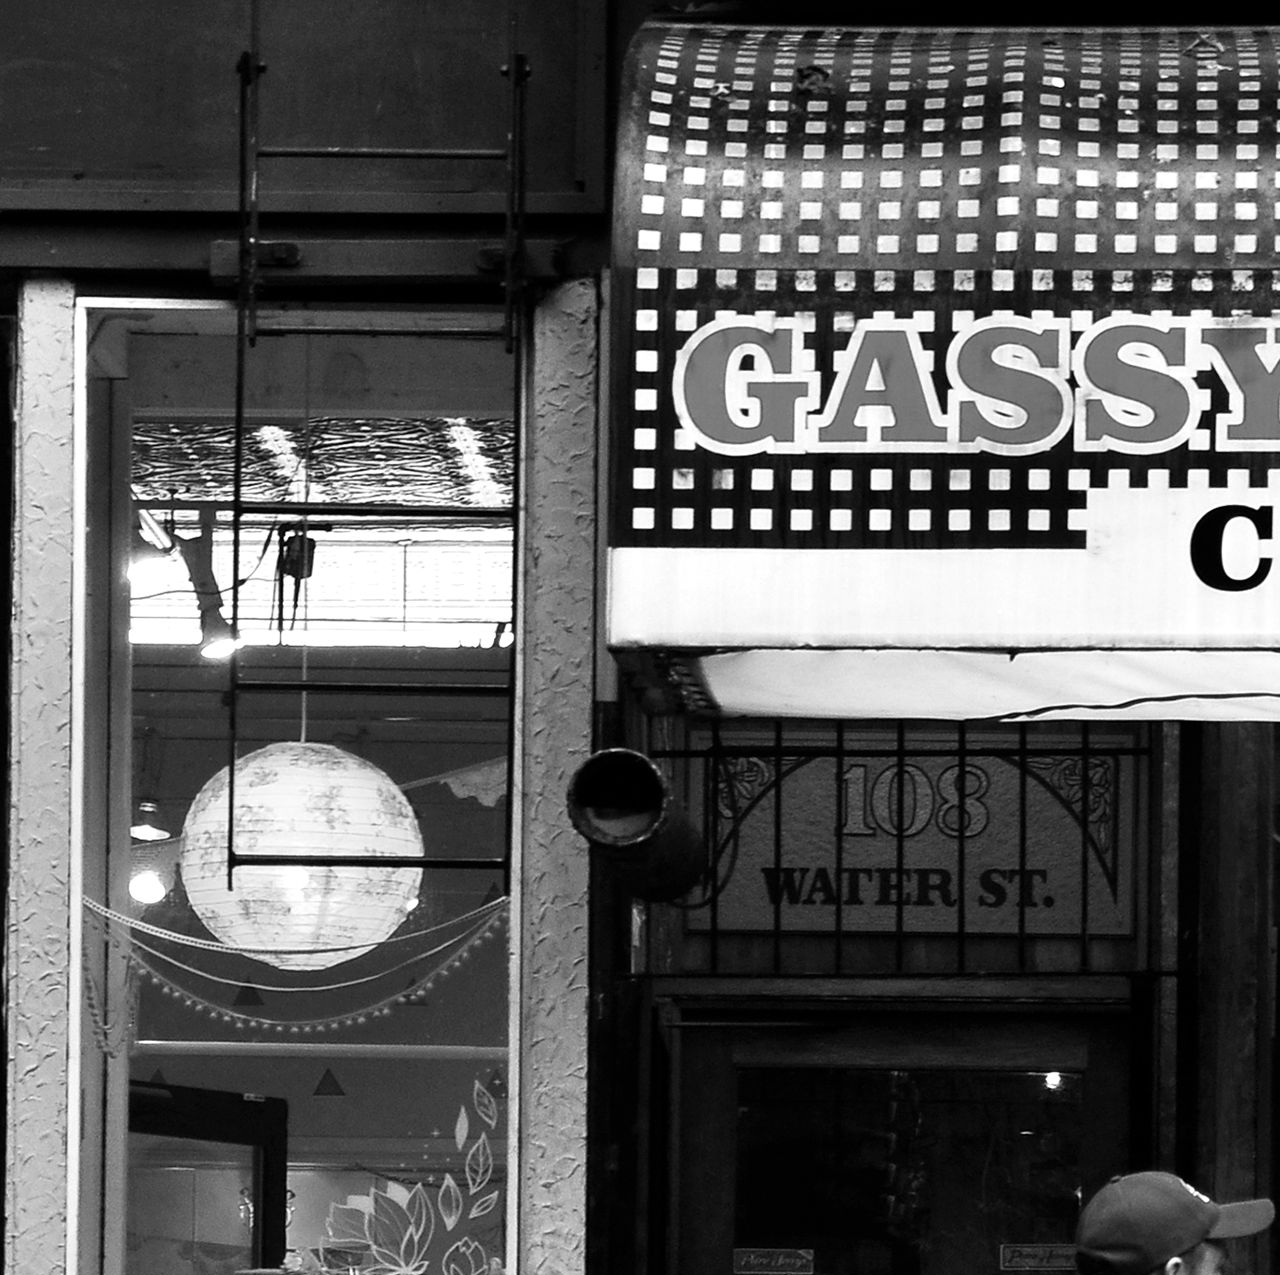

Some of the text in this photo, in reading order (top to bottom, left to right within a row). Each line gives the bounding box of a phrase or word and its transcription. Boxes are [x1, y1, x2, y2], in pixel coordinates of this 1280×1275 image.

[837, 763, 990, 838] 108
[761, 866, 1055, 909] WATER ST.
